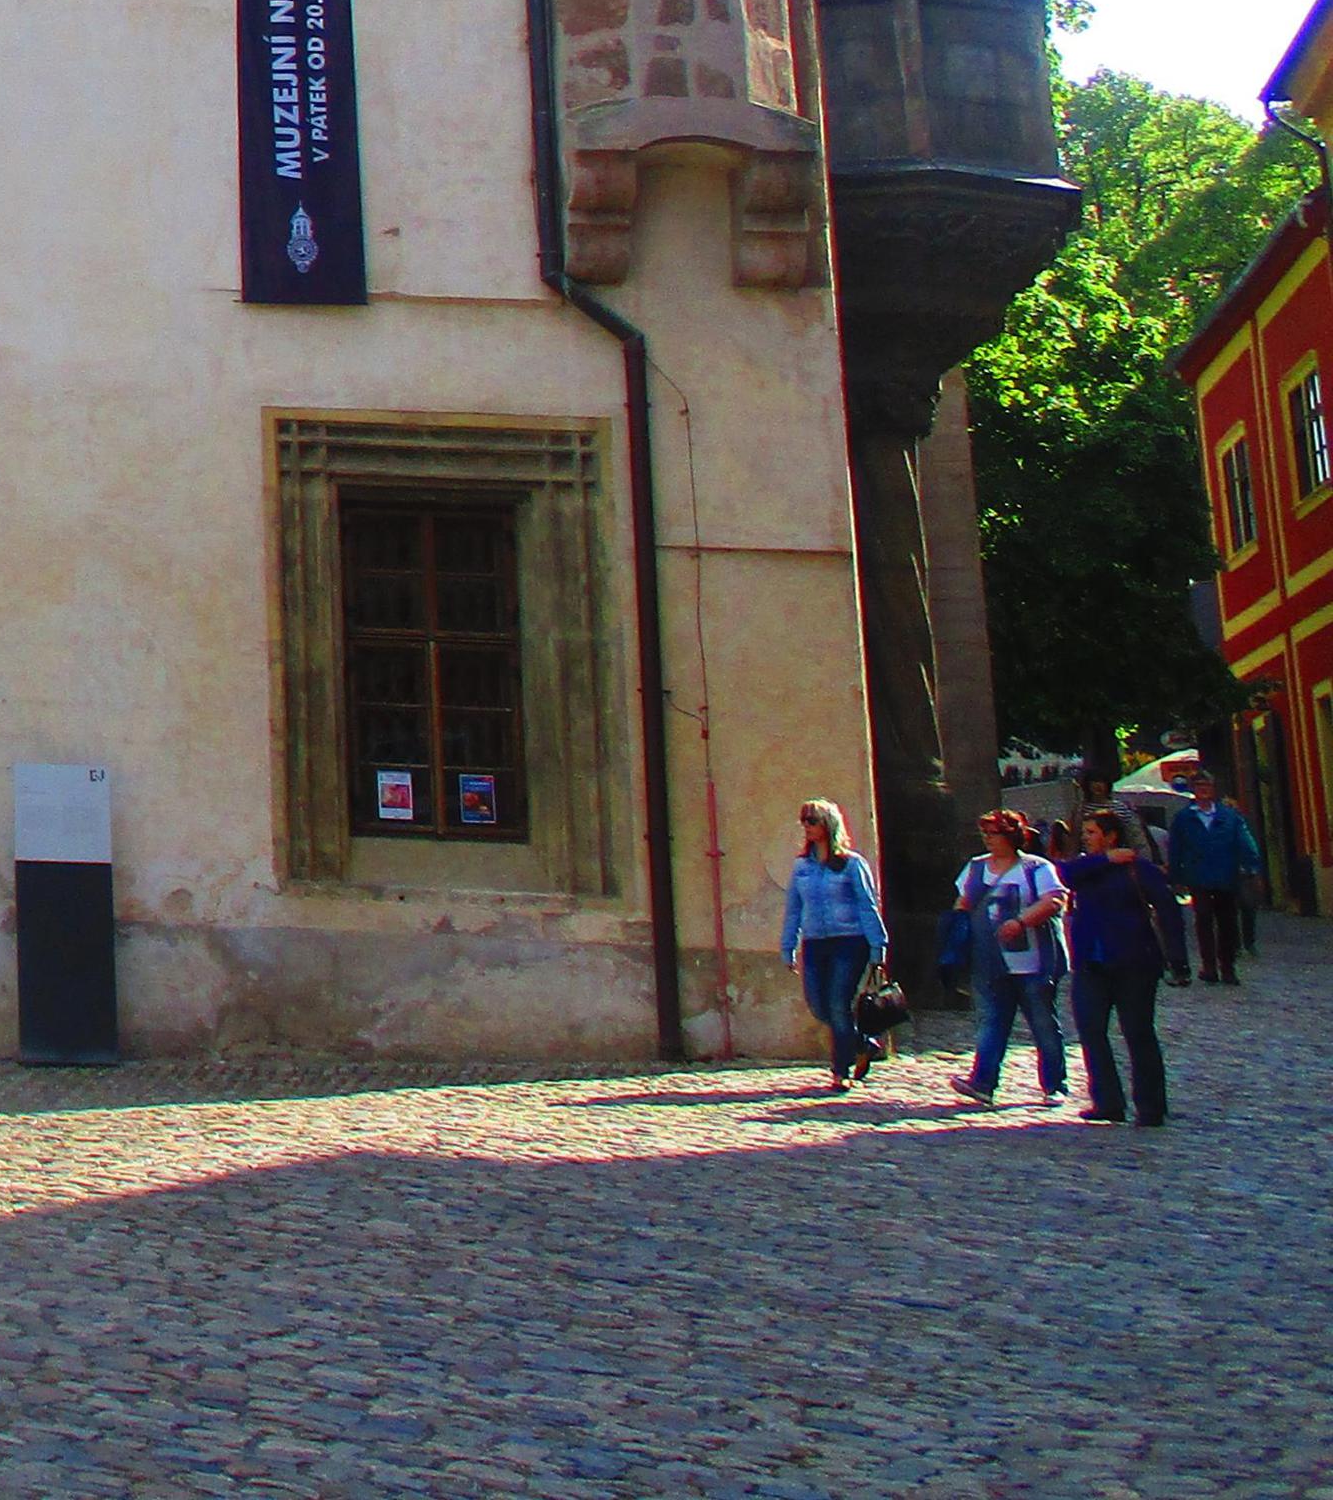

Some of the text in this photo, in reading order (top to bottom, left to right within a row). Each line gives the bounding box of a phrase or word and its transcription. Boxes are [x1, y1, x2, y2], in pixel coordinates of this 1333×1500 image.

[307, 37, 326, 70] OD
[262, 35, 302, 179] MUZEJNÍ
[306, 76, 329, 141] PÁTEK
[312, 147, 330, 162] V
